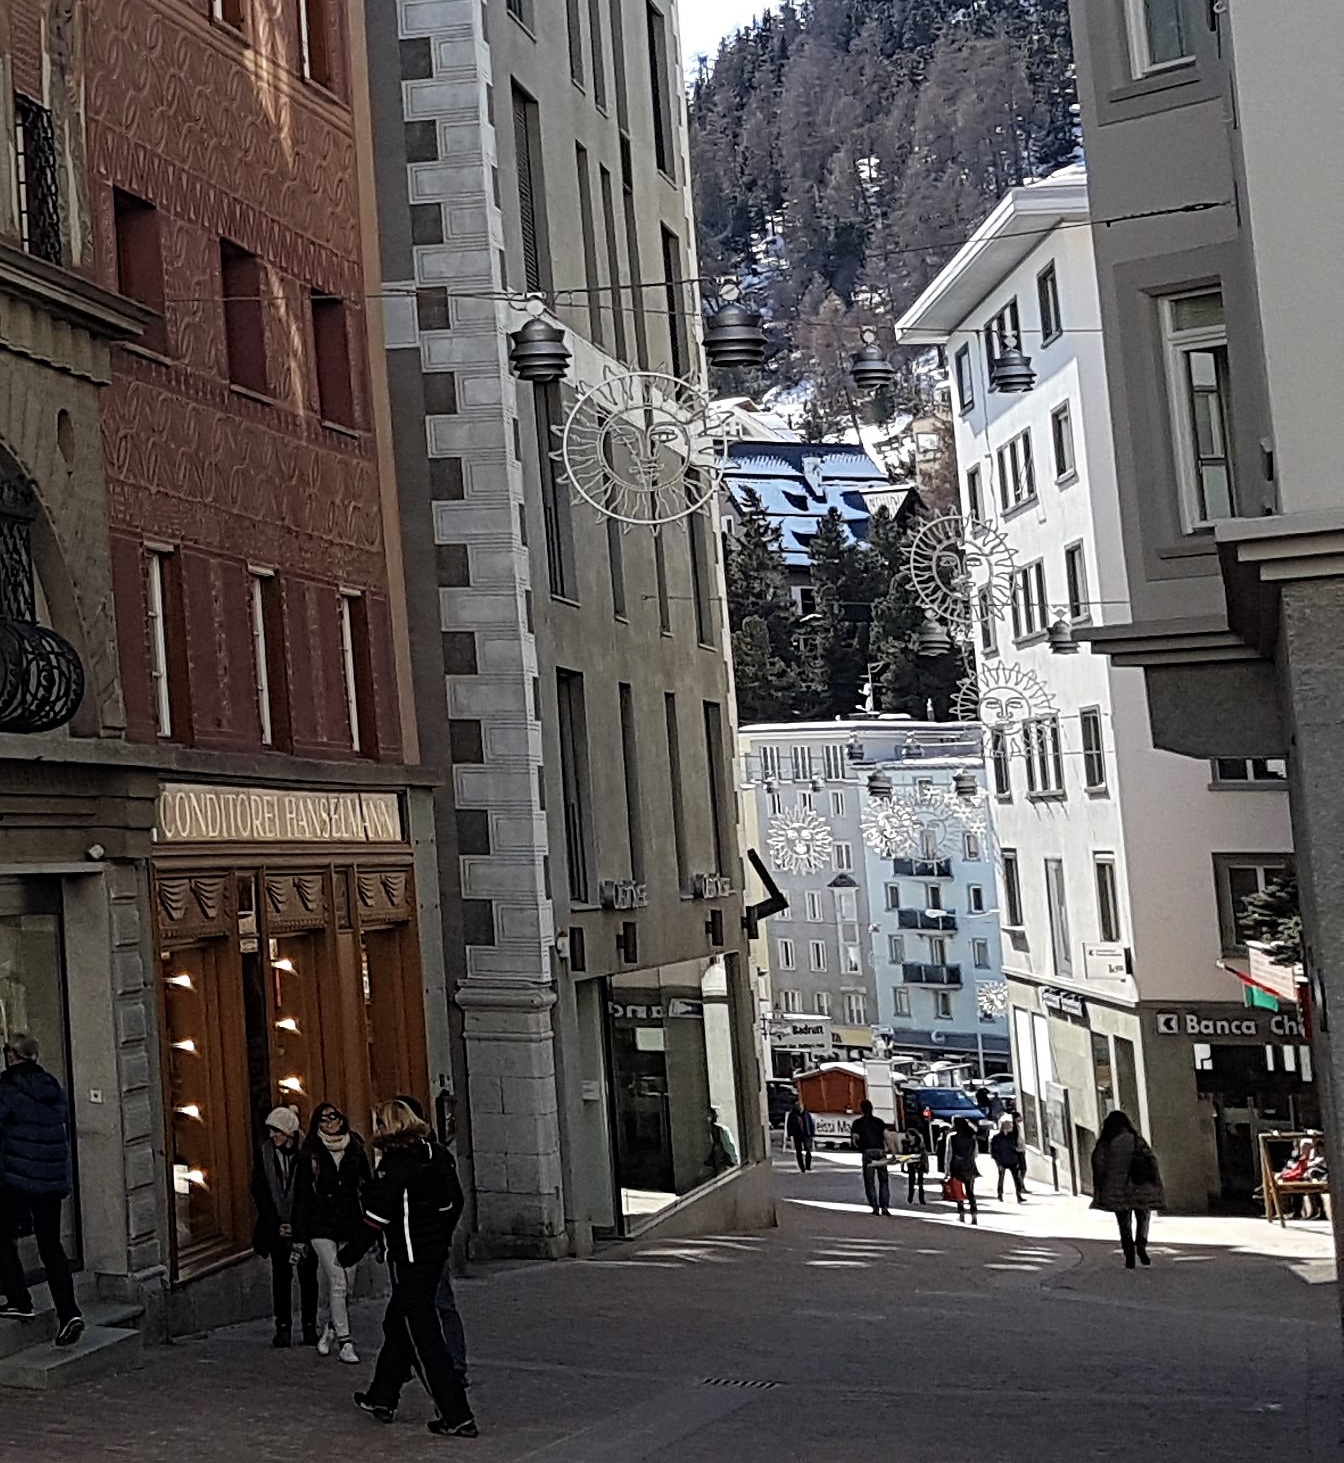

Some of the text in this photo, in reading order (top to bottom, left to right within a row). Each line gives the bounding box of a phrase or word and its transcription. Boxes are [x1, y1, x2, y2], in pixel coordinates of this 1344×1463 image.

[160, 791, 396, 839] CONDITOREI HANSELMANN
[1185, 1014, 1303, 1035] Banca Ch
[816, 1119, 835, 1133] eissi
